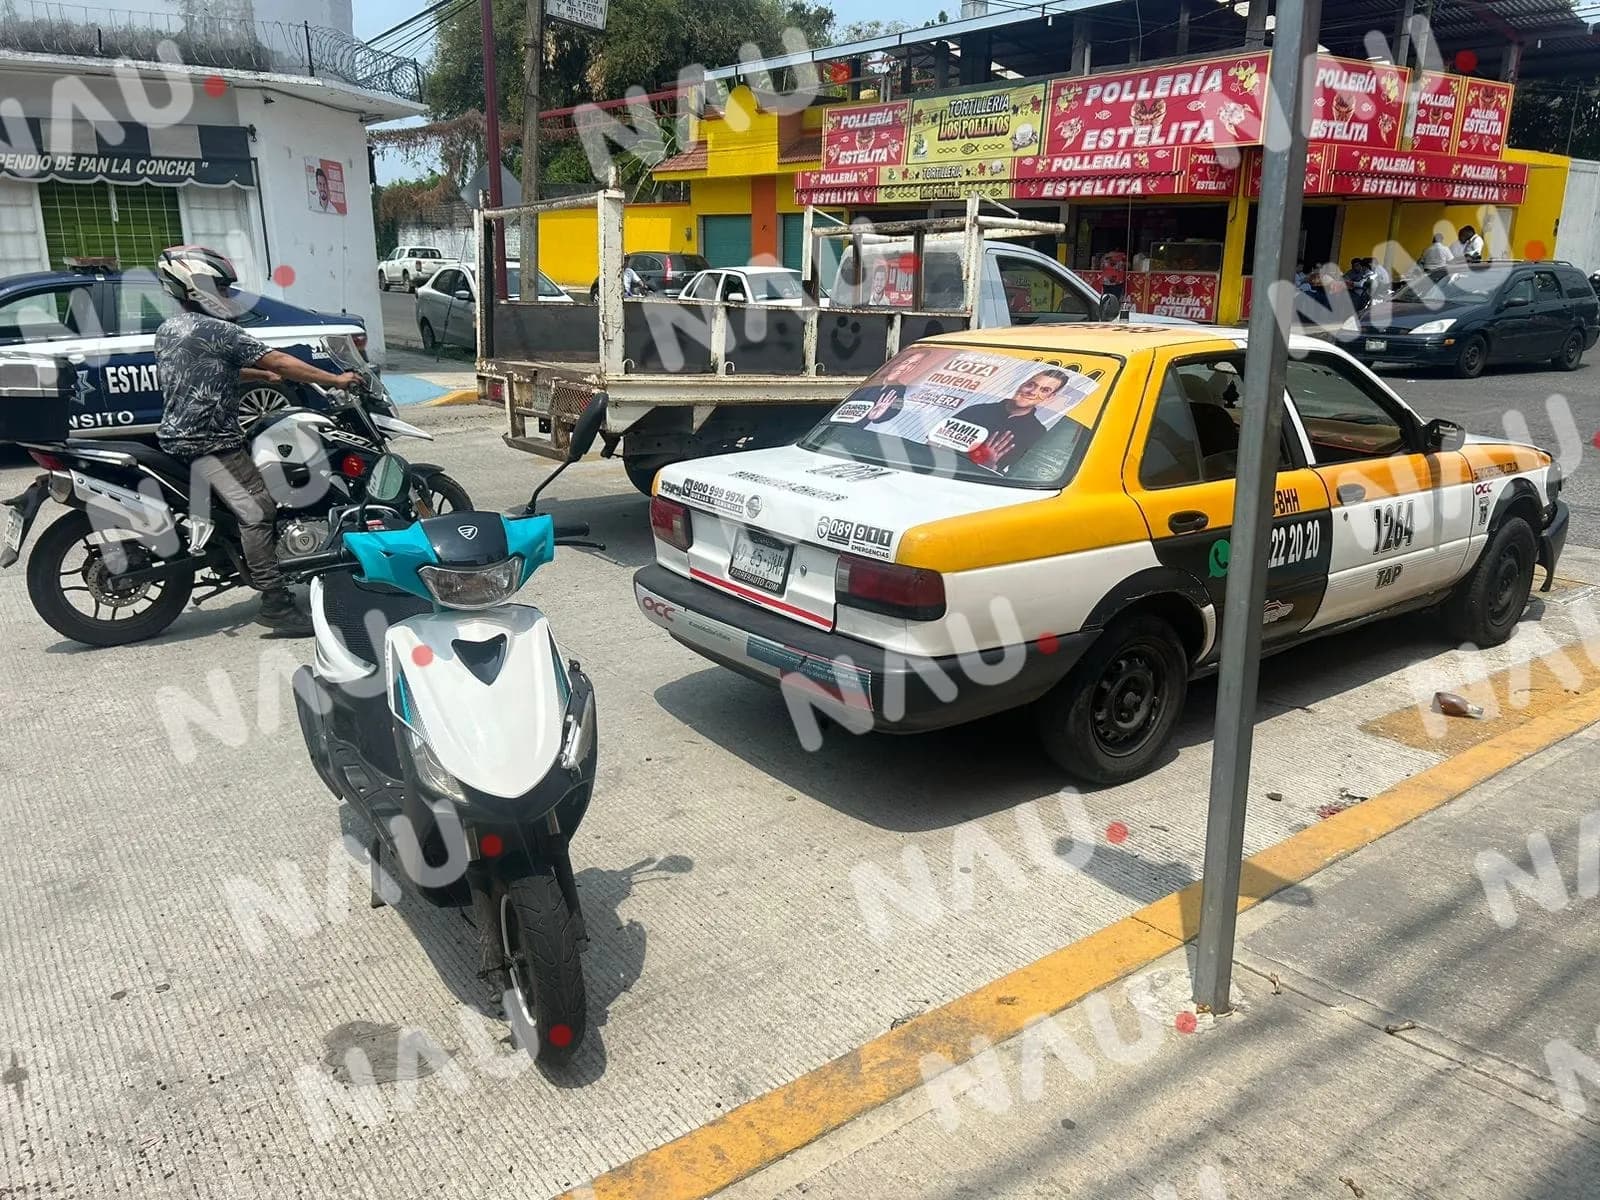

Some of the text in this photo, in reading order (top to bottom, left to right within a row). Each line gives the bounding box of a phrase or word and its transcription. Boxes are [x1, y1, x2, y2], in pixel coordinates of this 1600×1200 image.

[1083, 66, 1223, 107] POLLERÍA
[1315, 68, 1376, 94] POLLERÍA
[840, 107, 893, 129] POLLERÍA
[960, 114, 1010, 138] POLLITOS
[1463, 118, 1502, 135] ESTELITA
[1081, 119, 1215, 152] ESTELITA
[1310, 119, 1368, 143] ESTELITA
[1416, 122, 1450, 138] ESTELITA
[54, 155, 76, 171] DE
[78, 156, 109, 173] PAN
[110, 158, 131, 174] LA
[135, 158, 195, 176] CONCHA
[838, 149, 888, 166] ESTELITA
[1051, 150, 1132, 172] POLLERÍA
[1370, 155, 1415, 173] POLLERÍA
[820, 170, 858, 184] POLLERÍA
[1461, 164, 1499, 181] POLLERÍA
[1042, 178, 1144, 197] ESTELITA
[1362, 177, 1417, 196] ESTELITA
[1453, 184, 1499, 200] ESTELITA
[811, 190, 859, 204] ESTELITA
[1153, 304, 1206, 319] ESTELITA
[947, 360, 994, 377] VOTA
[928, 373, 980, 390] morena
[935, 427, 976, 446] MELGAR
[944, 418, 980, 439] YAMIL
[692, 481, 709, 494] 800
[708, 485, 725, 498] 999
[725, 490, 746, 504] 9974
[1273, 488, 1301, 515] -BHH
[830, 520, 890, 546] 089 911
[1373, 500, 1415, 556] 1264
[1287, 523, 1304, 564] 20
[1304, 519, 1320, 560] 20
[851, 545, 889, 559] EMERGENCIAS
[1375, 563, 1403, 590] TAP
